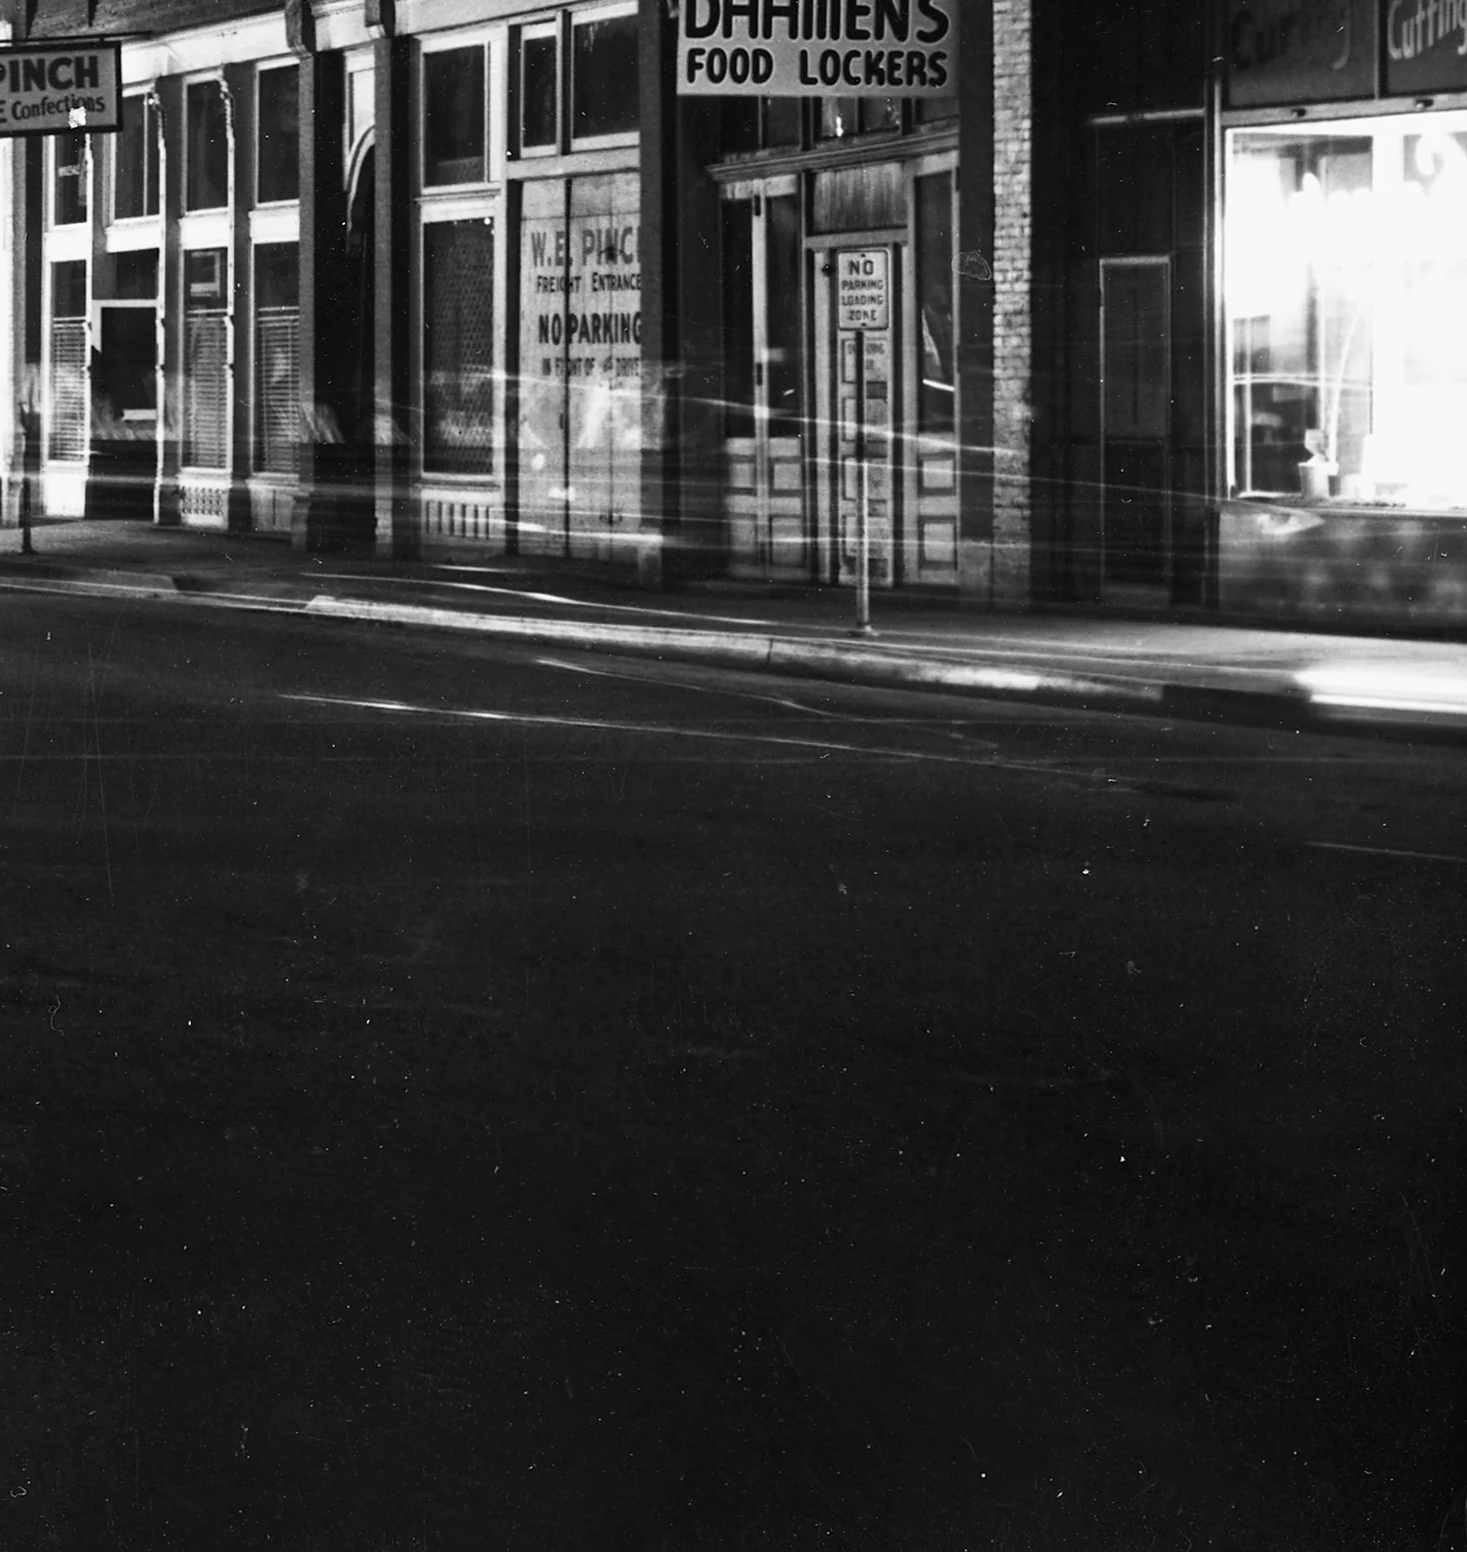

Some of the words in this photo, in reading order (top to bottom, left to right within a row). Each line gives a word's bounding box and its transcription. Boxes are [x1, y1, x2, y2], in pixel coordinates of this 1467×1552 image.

[687, 48, 774, 84] FOOD
[799, 48, 948, 86] LOCKERS
[12, 94, 106, 122] Confections
[582, 226, 641, 266] PINC
[848, 260, 874, 276] NO
[592, 271, 642, 292] ENTRANCE
[841, 280, 884, 291] PARKING
[842, 295, 884, 306] LOADING
[849, 310, 878, 321] ZONE
[539, 313, 563, 346] NO
[568, 311, 642, 345] PARKING
